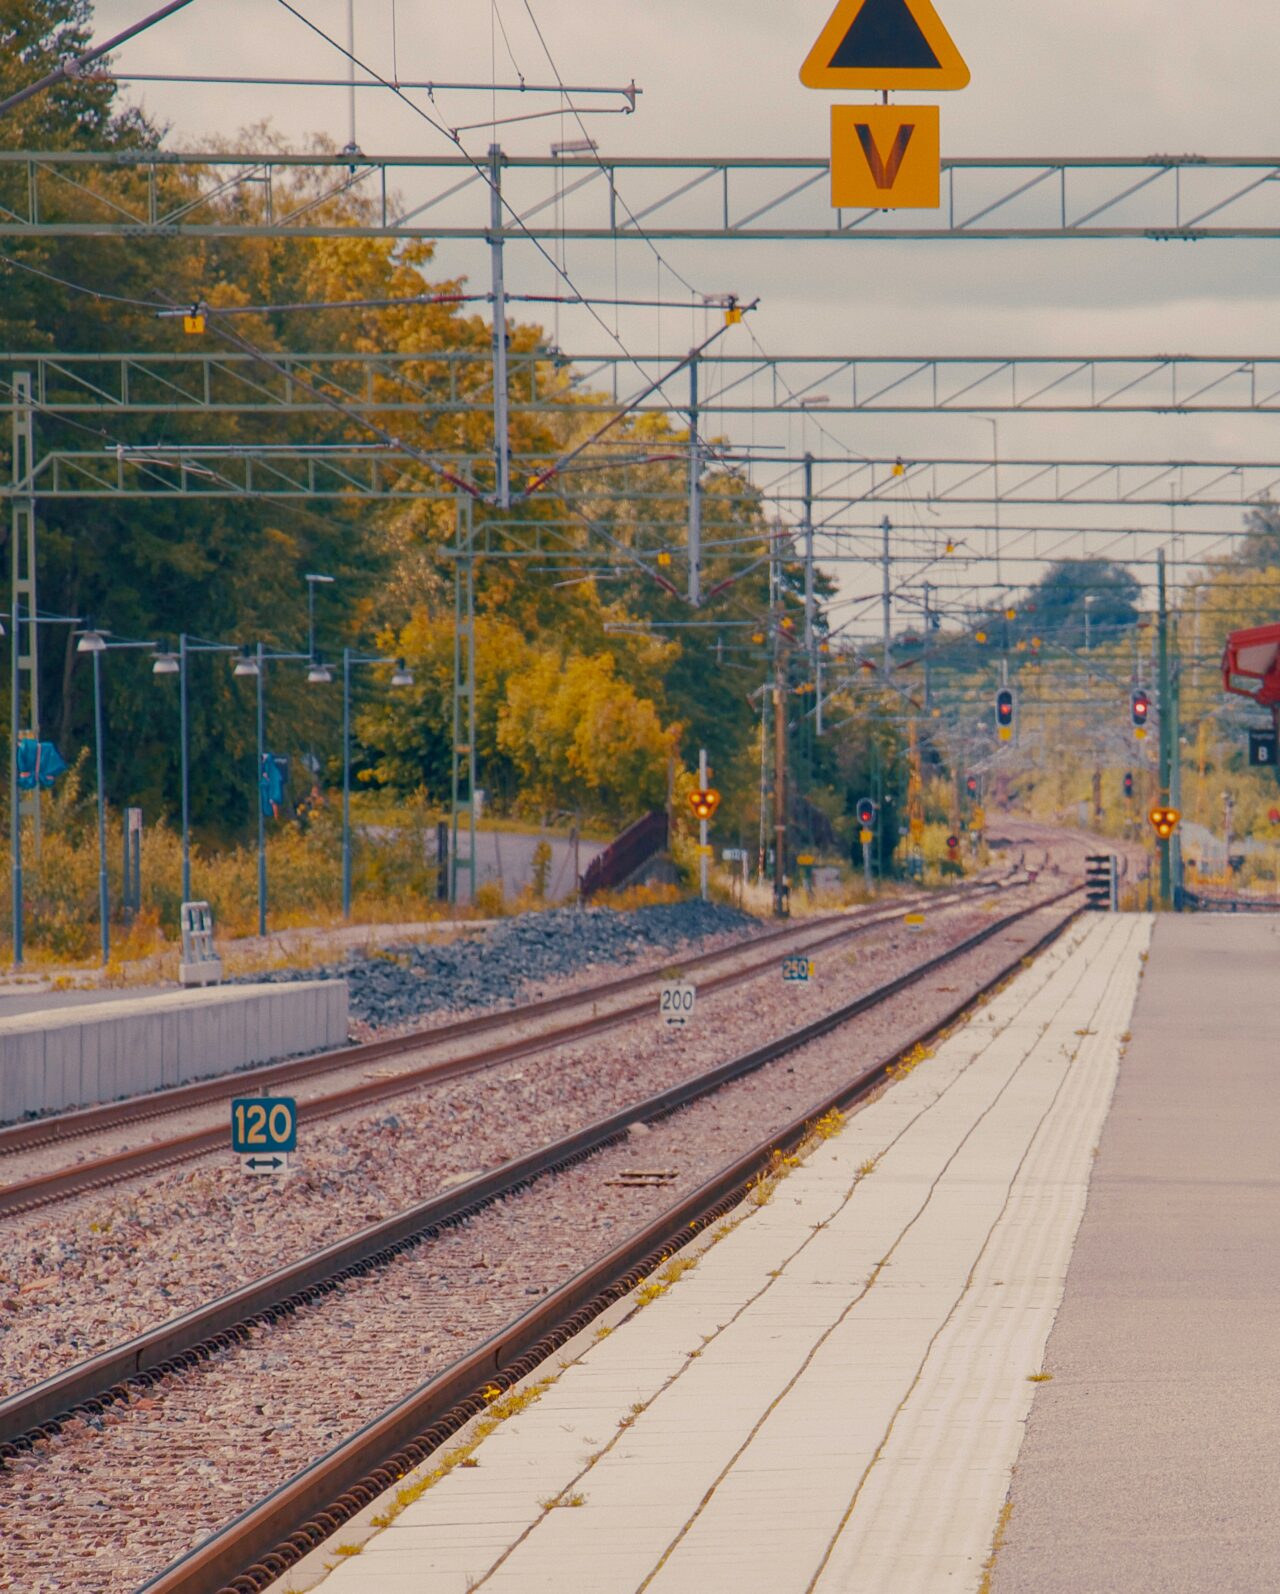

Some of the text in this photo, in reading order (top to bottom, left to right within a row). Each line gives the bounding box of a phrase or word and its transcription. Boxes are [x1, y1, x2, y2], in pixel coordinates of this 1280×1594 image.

[853, 123, 915, 190] V
[1258, 746, 1268, 761] B
[662, 990, 693, 1011] 200
[235, 1104, 292, 1144] 120
